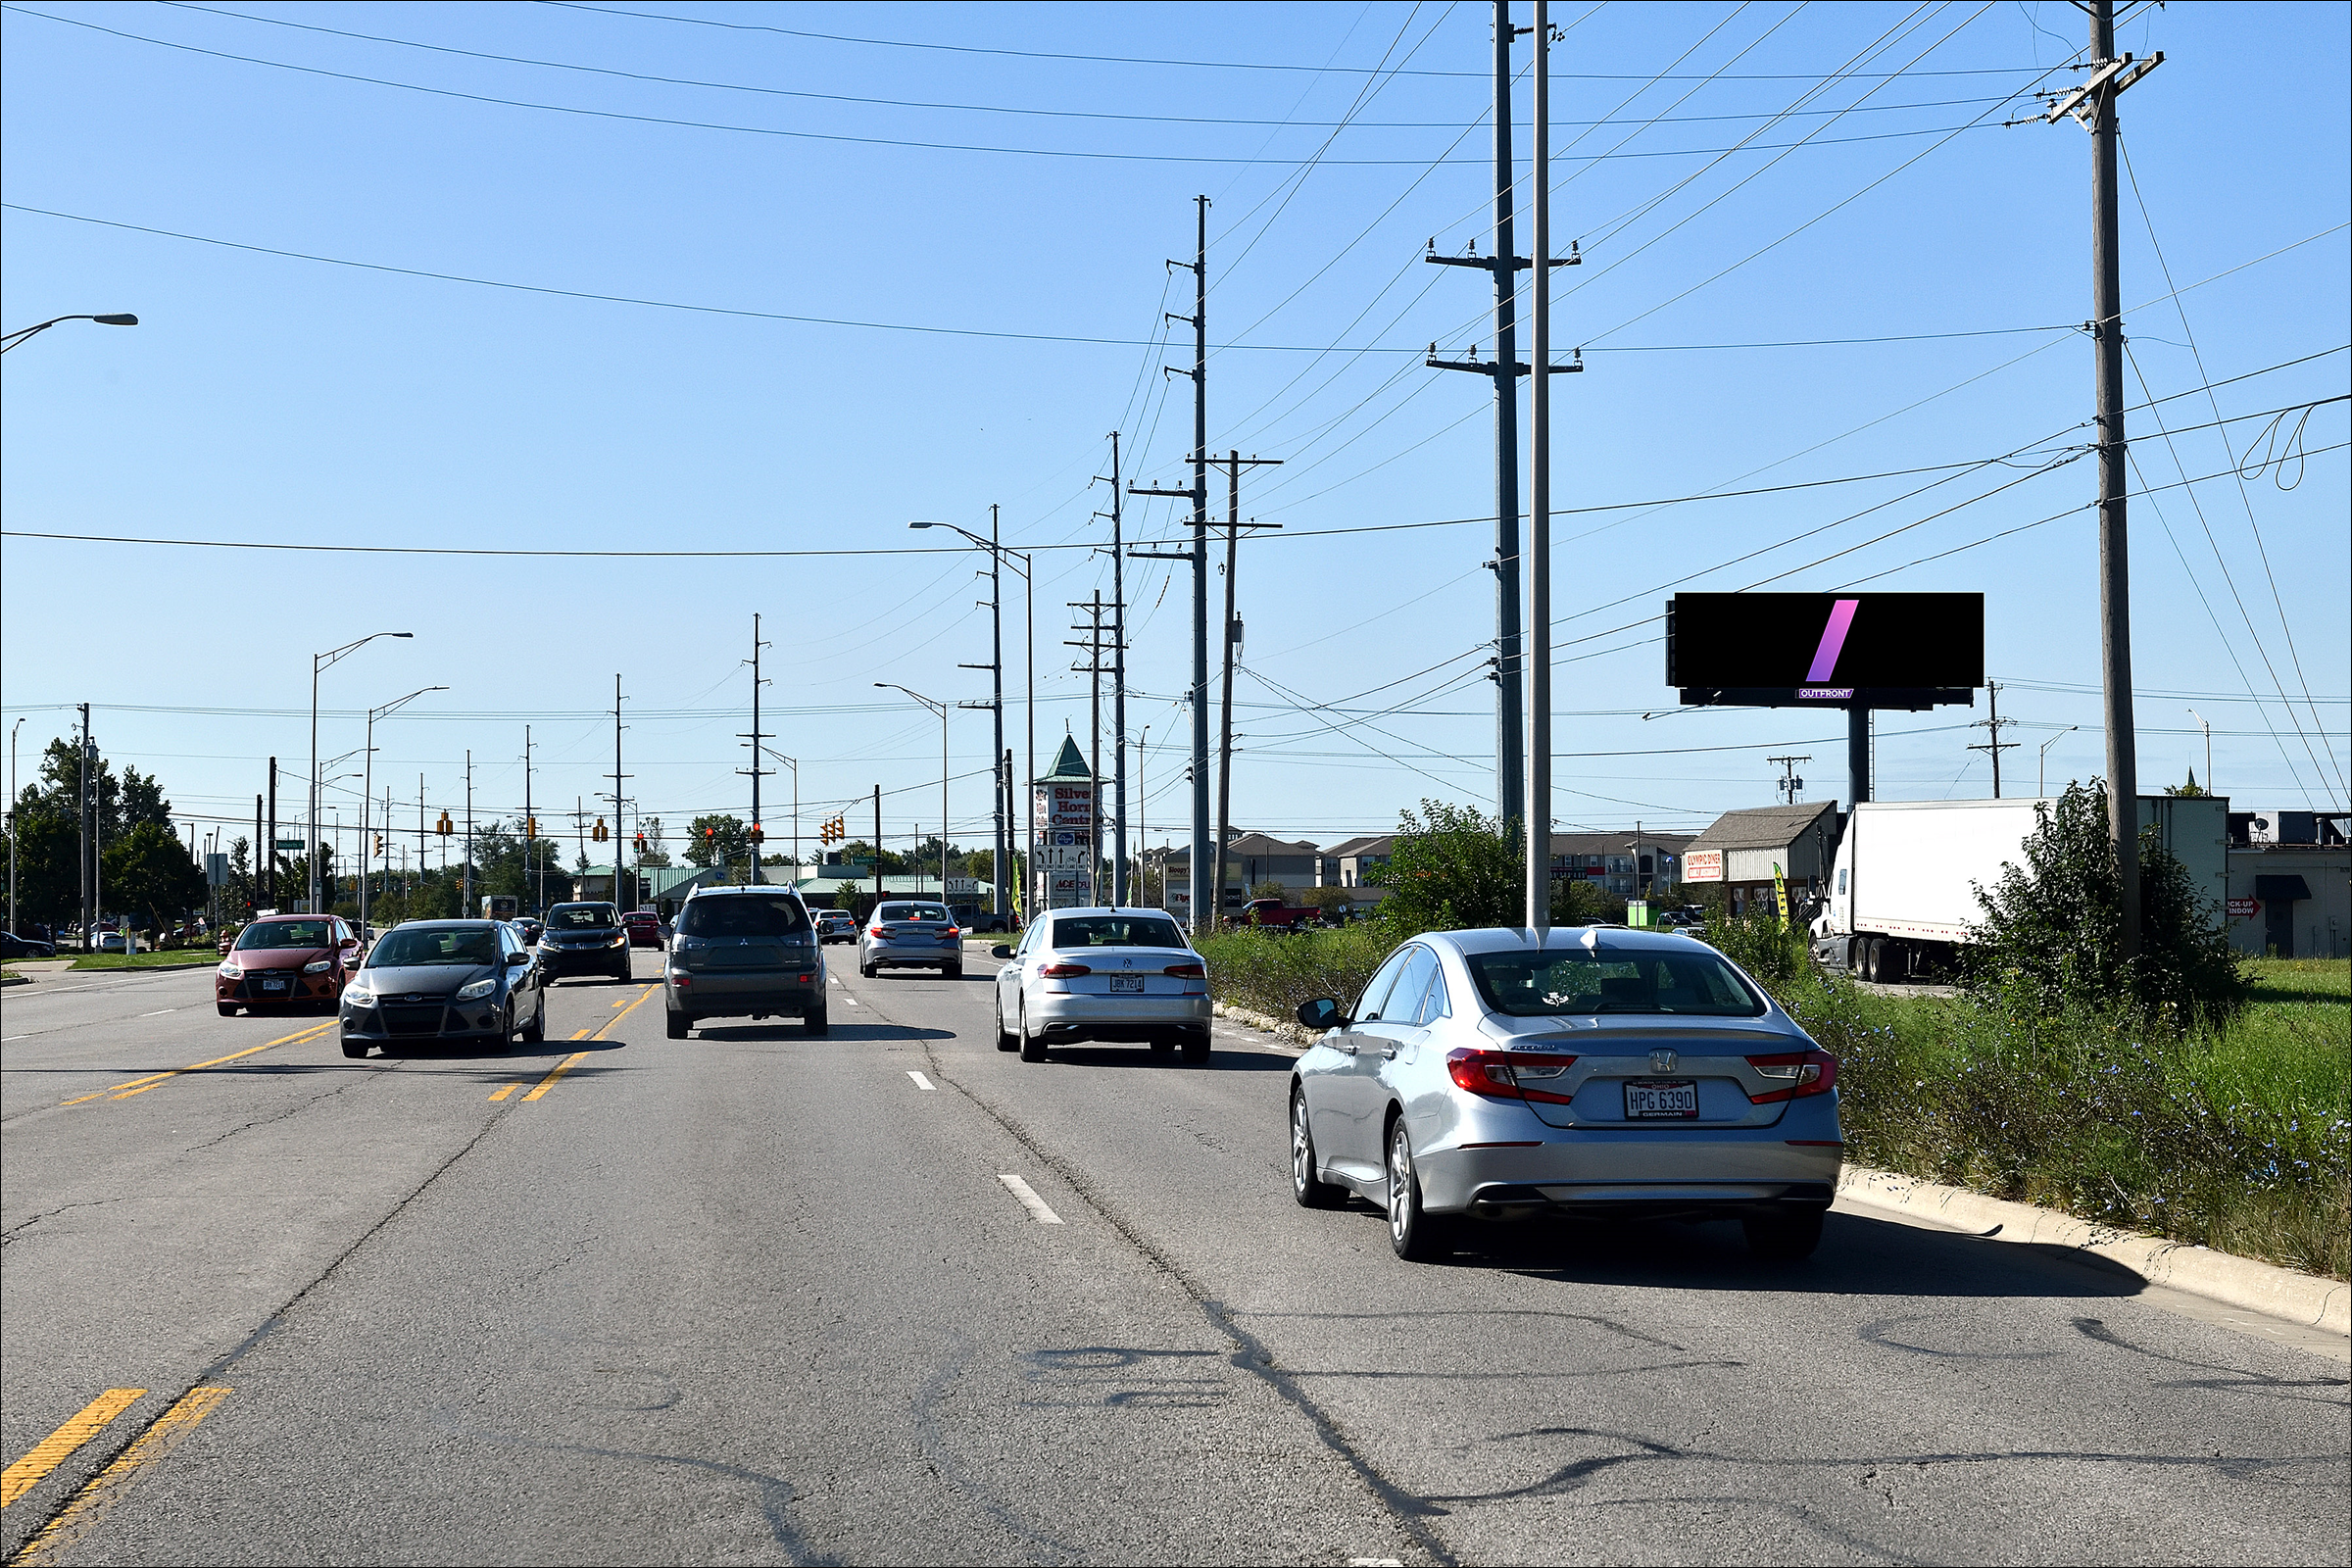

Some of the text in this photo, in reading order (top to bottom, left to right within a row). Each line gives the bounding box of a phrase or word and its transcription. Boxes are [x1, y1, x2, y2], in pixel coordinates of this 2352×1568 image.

[1800, 689, 1850, 698] OUTFRONT
[1052, 814, 1092, 825] Centr
[1688, 853, 1721, 865] OLYMPIC DINER
[1055, 879, 1076, 888] ACE
[1630, 1091, 1692, 1109] HPG 6390
